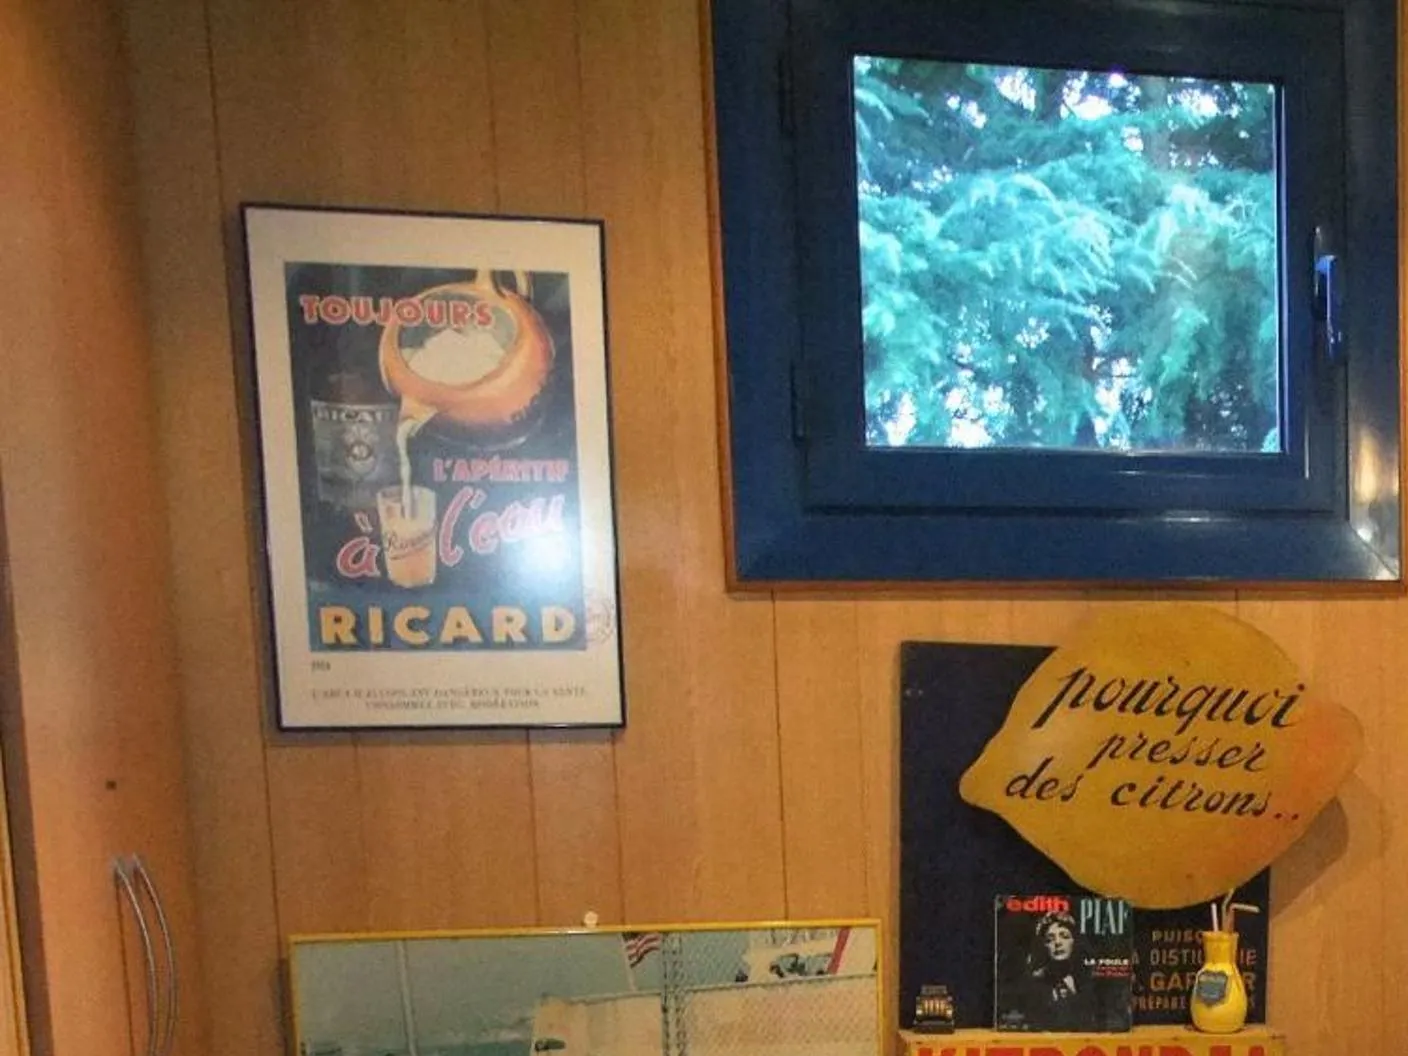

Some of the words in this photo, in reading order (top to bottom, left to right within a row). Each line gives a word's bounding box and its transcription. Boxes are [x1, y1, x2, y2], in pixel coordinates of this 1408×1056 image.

[301, 294, 495, 331] TOUJOURS
[319, 605, 576, 645] RICARD
[1031, 666, 1305, 736] pourquoi
[1087, 732, 1268, 772] presser
[1005, 755, 1083, 801] des
